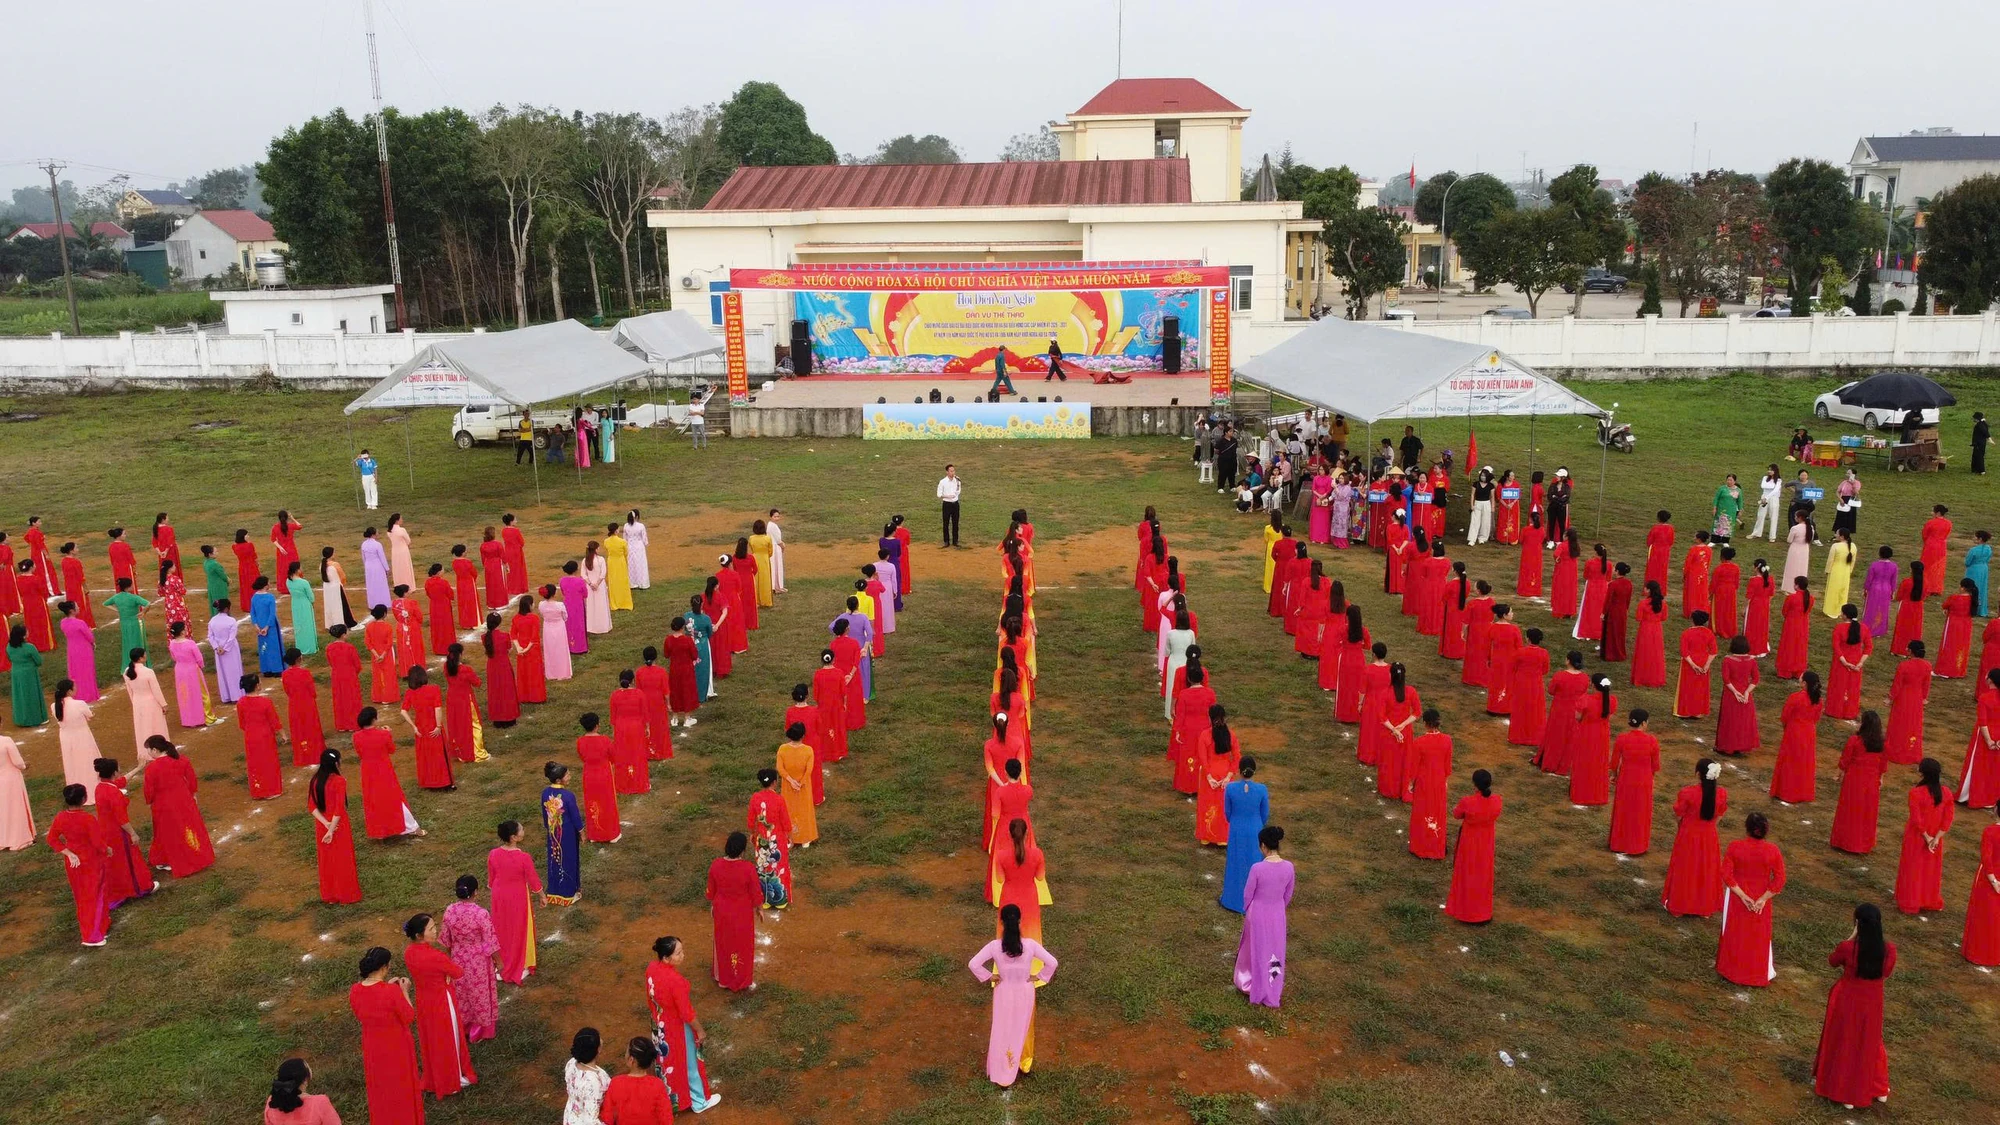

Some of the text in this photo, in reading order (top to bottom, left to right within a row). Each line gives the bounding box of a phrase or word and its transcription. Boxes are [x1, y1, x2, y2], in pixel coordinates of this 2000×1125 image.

[802, 271, 1151, 289] NƯỚC CỘNG HÒA XÃ HỘI CHỦ NGHĨA VIỆT NAM MUÔN NĂM
[1520, 379, 1534, 389] ANH
